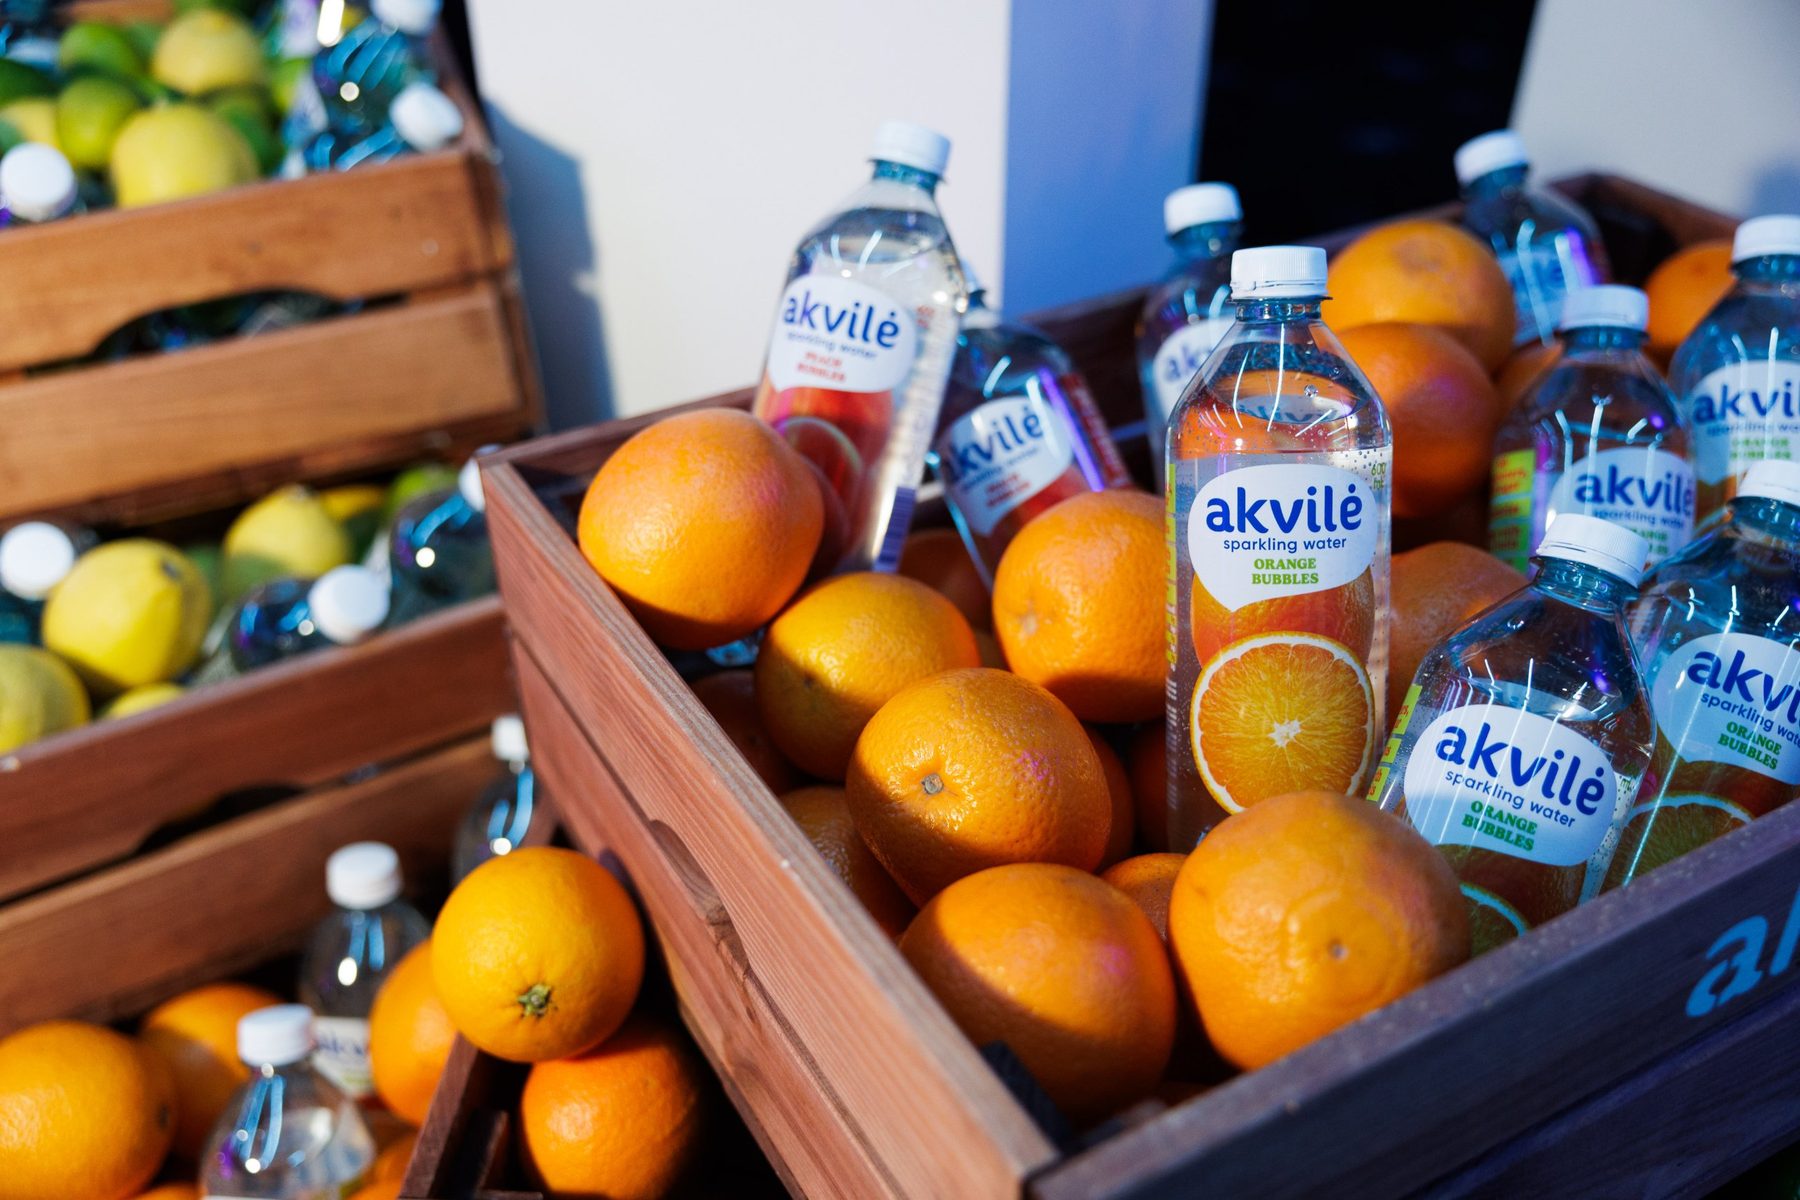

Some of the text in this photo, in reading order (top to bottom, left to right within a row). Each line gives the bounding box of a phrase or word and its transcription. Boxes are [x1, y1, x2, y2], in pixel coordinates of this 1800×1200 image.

[784, 290, 899, 348] akvilė
[1692, 380, 1800, 425] akvi
[1371, 462, 1386, 476] 600
[1205, 483, 1363, 534] akvilė
[1223, 537, 1347, 554] sparkling water
[1253, 558, 1317, 570] ORANGE
[1251, 572, 1319, 585] BUBBLES
[1687, 649, 1800, 724] akvi
[1700, 691, 1775, 733] sparkling
[1717, 733, 1779, 770] BUBBLES
[1726, 721, 1782, 756] ORANGE
[1435, 722, 1605, 816] akvilė
[1445, 770, 1576, 828] sparkling water
[1470, 800, 1538, 836] ORANGE
[1461, 813, 1535, 852] BUBBLES
